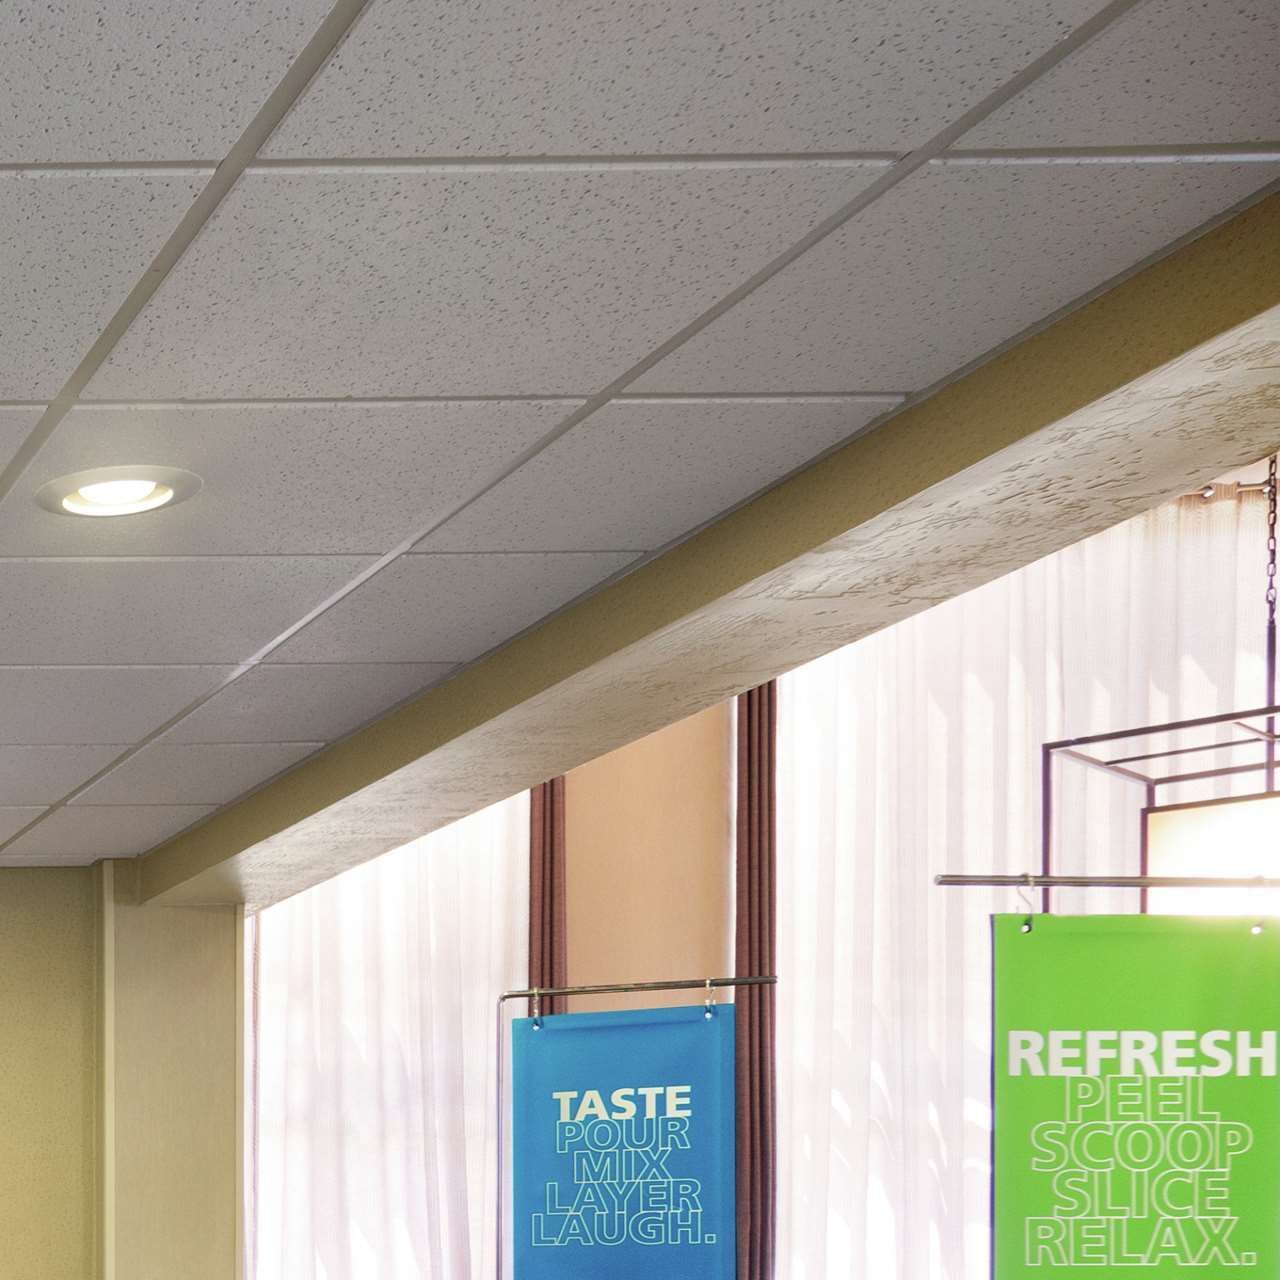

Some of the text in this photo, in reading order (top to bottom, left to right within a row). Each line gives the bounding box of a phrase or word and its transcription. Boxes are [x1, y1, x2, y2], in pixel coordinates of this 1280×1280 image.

[1007, 1030, 1277, 1077] REFRESH
[552, 1085, 692, 1123] TASTE
[1065, 1074, 1221, 1123] PEEL
[556, 1117, 691, 1153] POUR
[1030, 1120, 1254, 1172] SCOOP
[574, 1148, 672, 1184] MIX
[546, 1178, 703, 1215] LAYER
[1052, 1168, 1231, 1218] SLICE
[531, 1211, 717, 1246] LAUGH.
[1025, 1216, 1257, 1266] RELAX.
